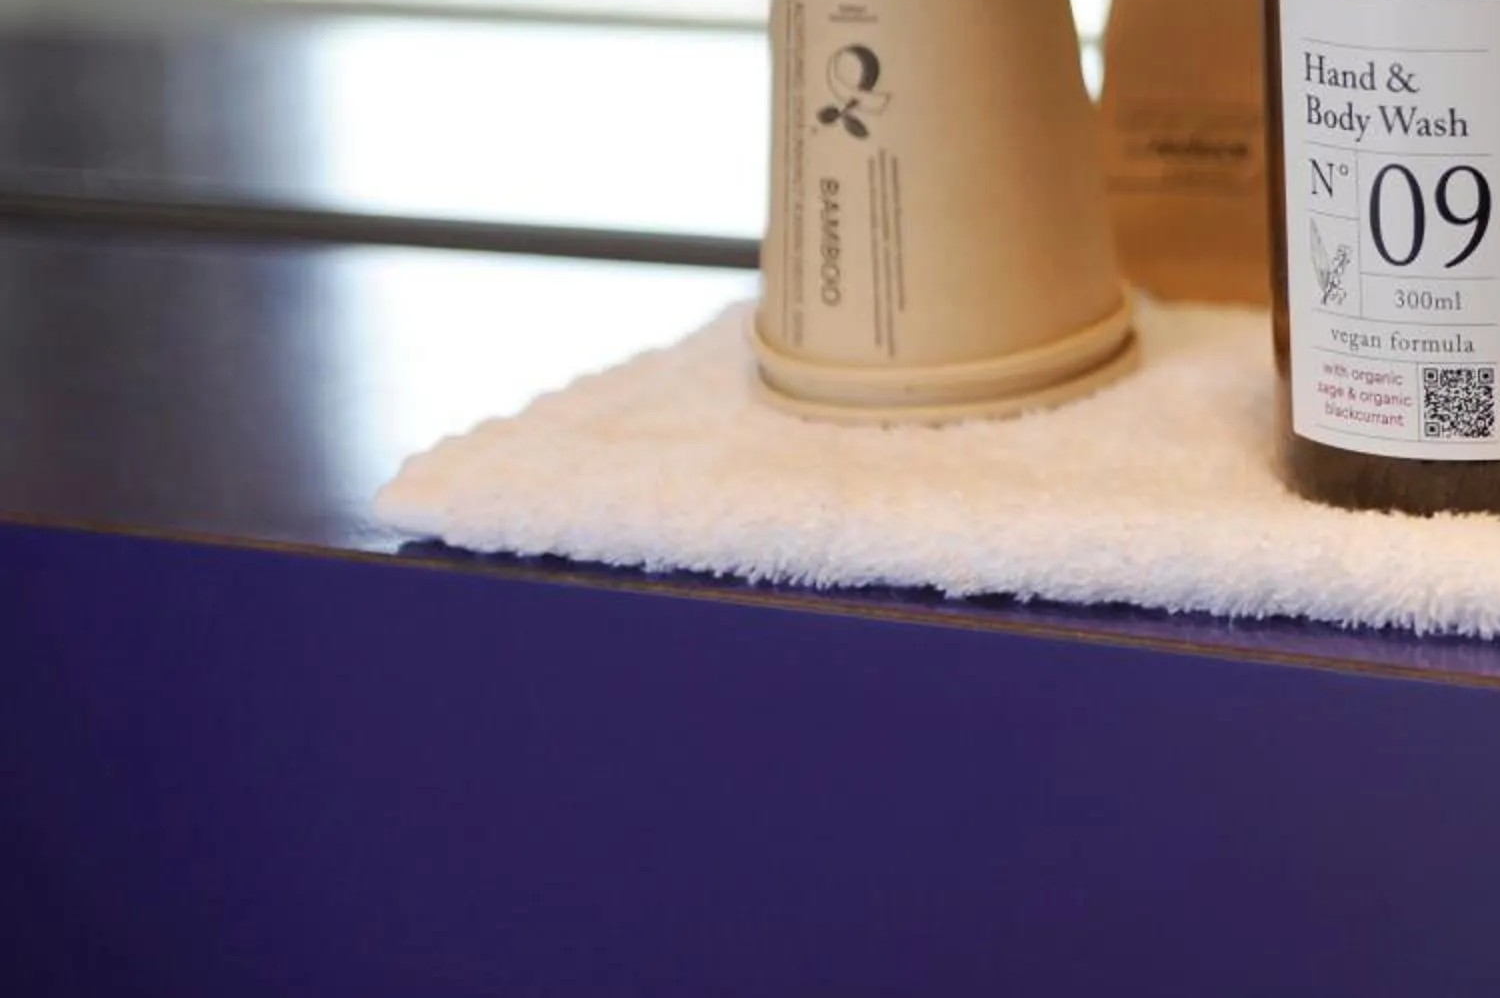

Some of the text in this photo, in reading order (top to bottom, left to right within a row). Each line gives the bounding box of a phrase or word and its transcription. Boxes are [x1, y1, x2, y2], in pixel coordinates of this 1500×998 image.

[1303, 51, 1420, 93] Hand &
[1305, 93, 1469, 142] Body Wash
[1369, 162, 1492, 269] 09
[819, 176, 842, 308] BAMBOO
[1394, 289, 1463, 311] 300ml
[1330, 326, 1475, 353] vegan formula
[1322, 363, 1405, 386] with organic
[1316, 381, 1414, 407] sage & organic
[1324, 401, 1405, 427] blackcurrant
